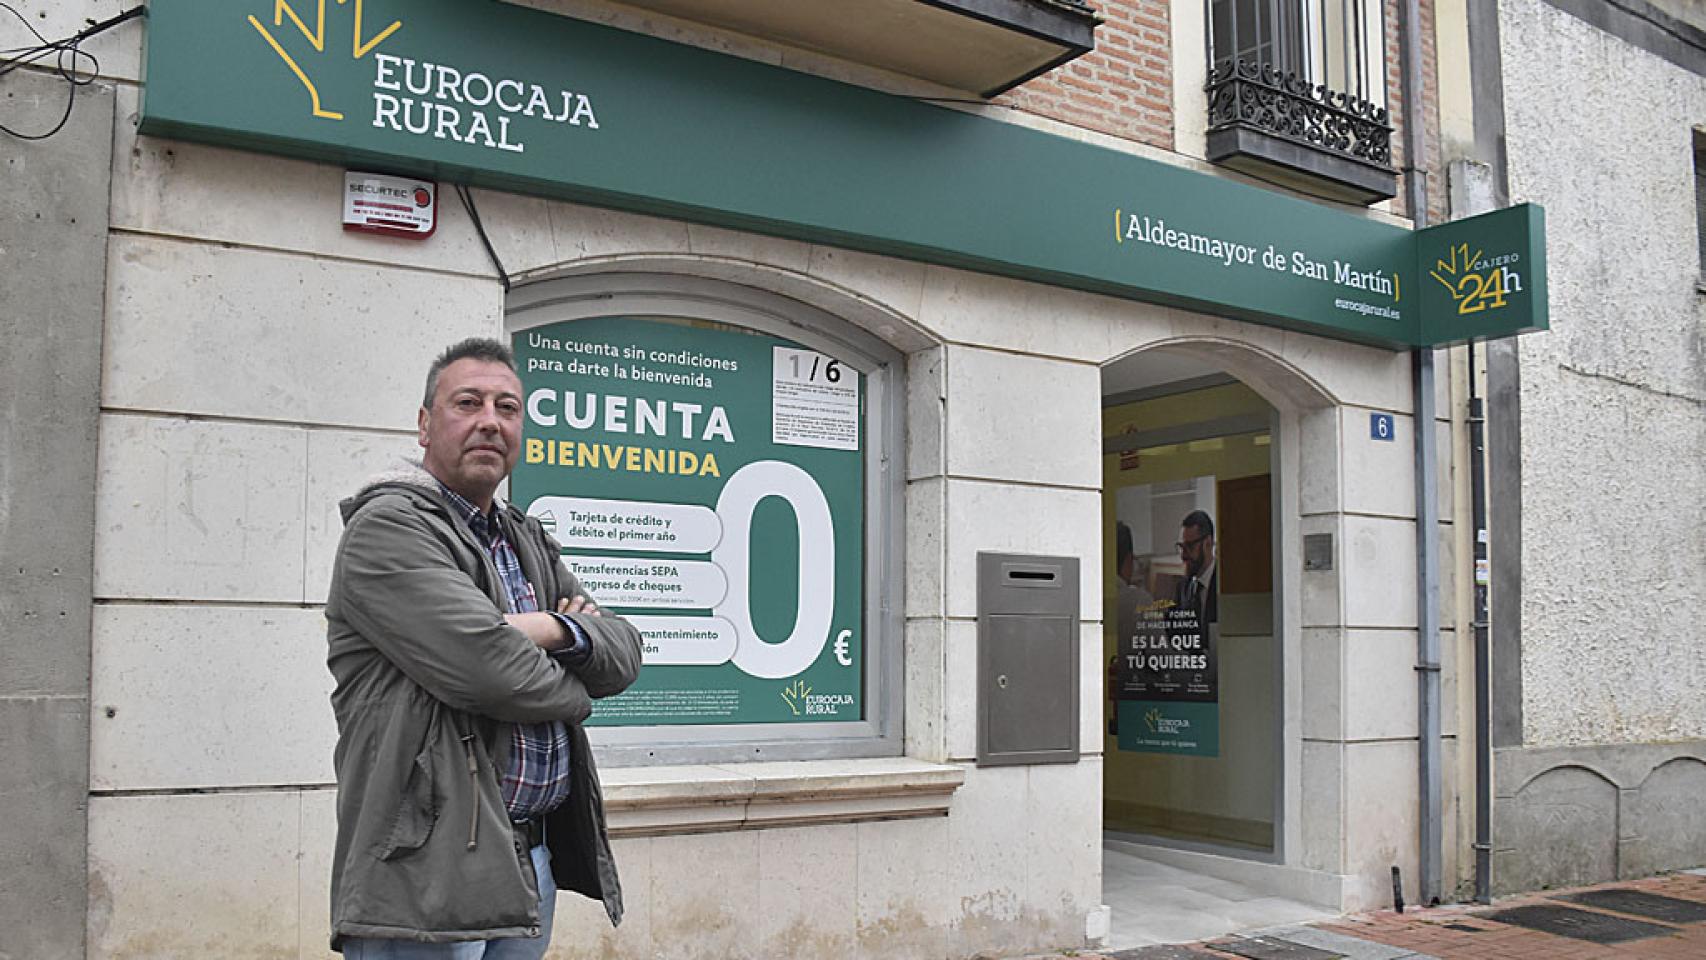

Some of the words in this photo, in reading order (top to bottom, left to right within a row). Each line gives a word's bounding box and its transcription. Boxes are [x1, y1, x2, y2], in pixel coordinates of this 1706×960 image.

[374, 53, 599, 129] EUROCAJA
[372, 92, 524, 153] RURAL
[1262, 245, 1287, 271] de
[1292, 251, 1328, 281] San
[1474, 252, 1519, 270] CAJERO
[529, 333, 561, 350] Una
[565, 339, 619, 358] cuenta
[623, 345, 646, 360] sin
[650, 350, 738, 371] condiciones
[527, 357, 564, 372] para
[567, 358, 609, 378] darte
[614, 363, 628, 379] la
[631, 365, 713, 388] bienvenida
[527, 388, 735, 443] CUENTA
[1379, 417, 1387, 437] 6
[525, 438, 721, 478] BIENVENIDA
[570, 511, 607, 525] Tarjeta
[609, 513, 624, 524] de
[626, 515, 663, 526] crédito
[664, 519, 672, 528] y
[569, 526, 605, 538] débito
[607, 528, 617, 539] el
[619, 529, 655, 541] primer
[656, 531, 676, 541] año
[571, 562, 649, 577] Transferencias
[651, 565, 679, 577] SEPA
[622, 580, 636, 592] de
[639, 579, 682, 594] cheques
[640, 628, 719, 640] mantenimiento
[1132, 634, 1147, 649] ES
[1150, 634, 1168, 649] LA
[1171, 634, 1201, 651] QUE
[1127, 651, 1145, 669] TÚ
[1148, 654, 1207, 672] QUIERES
